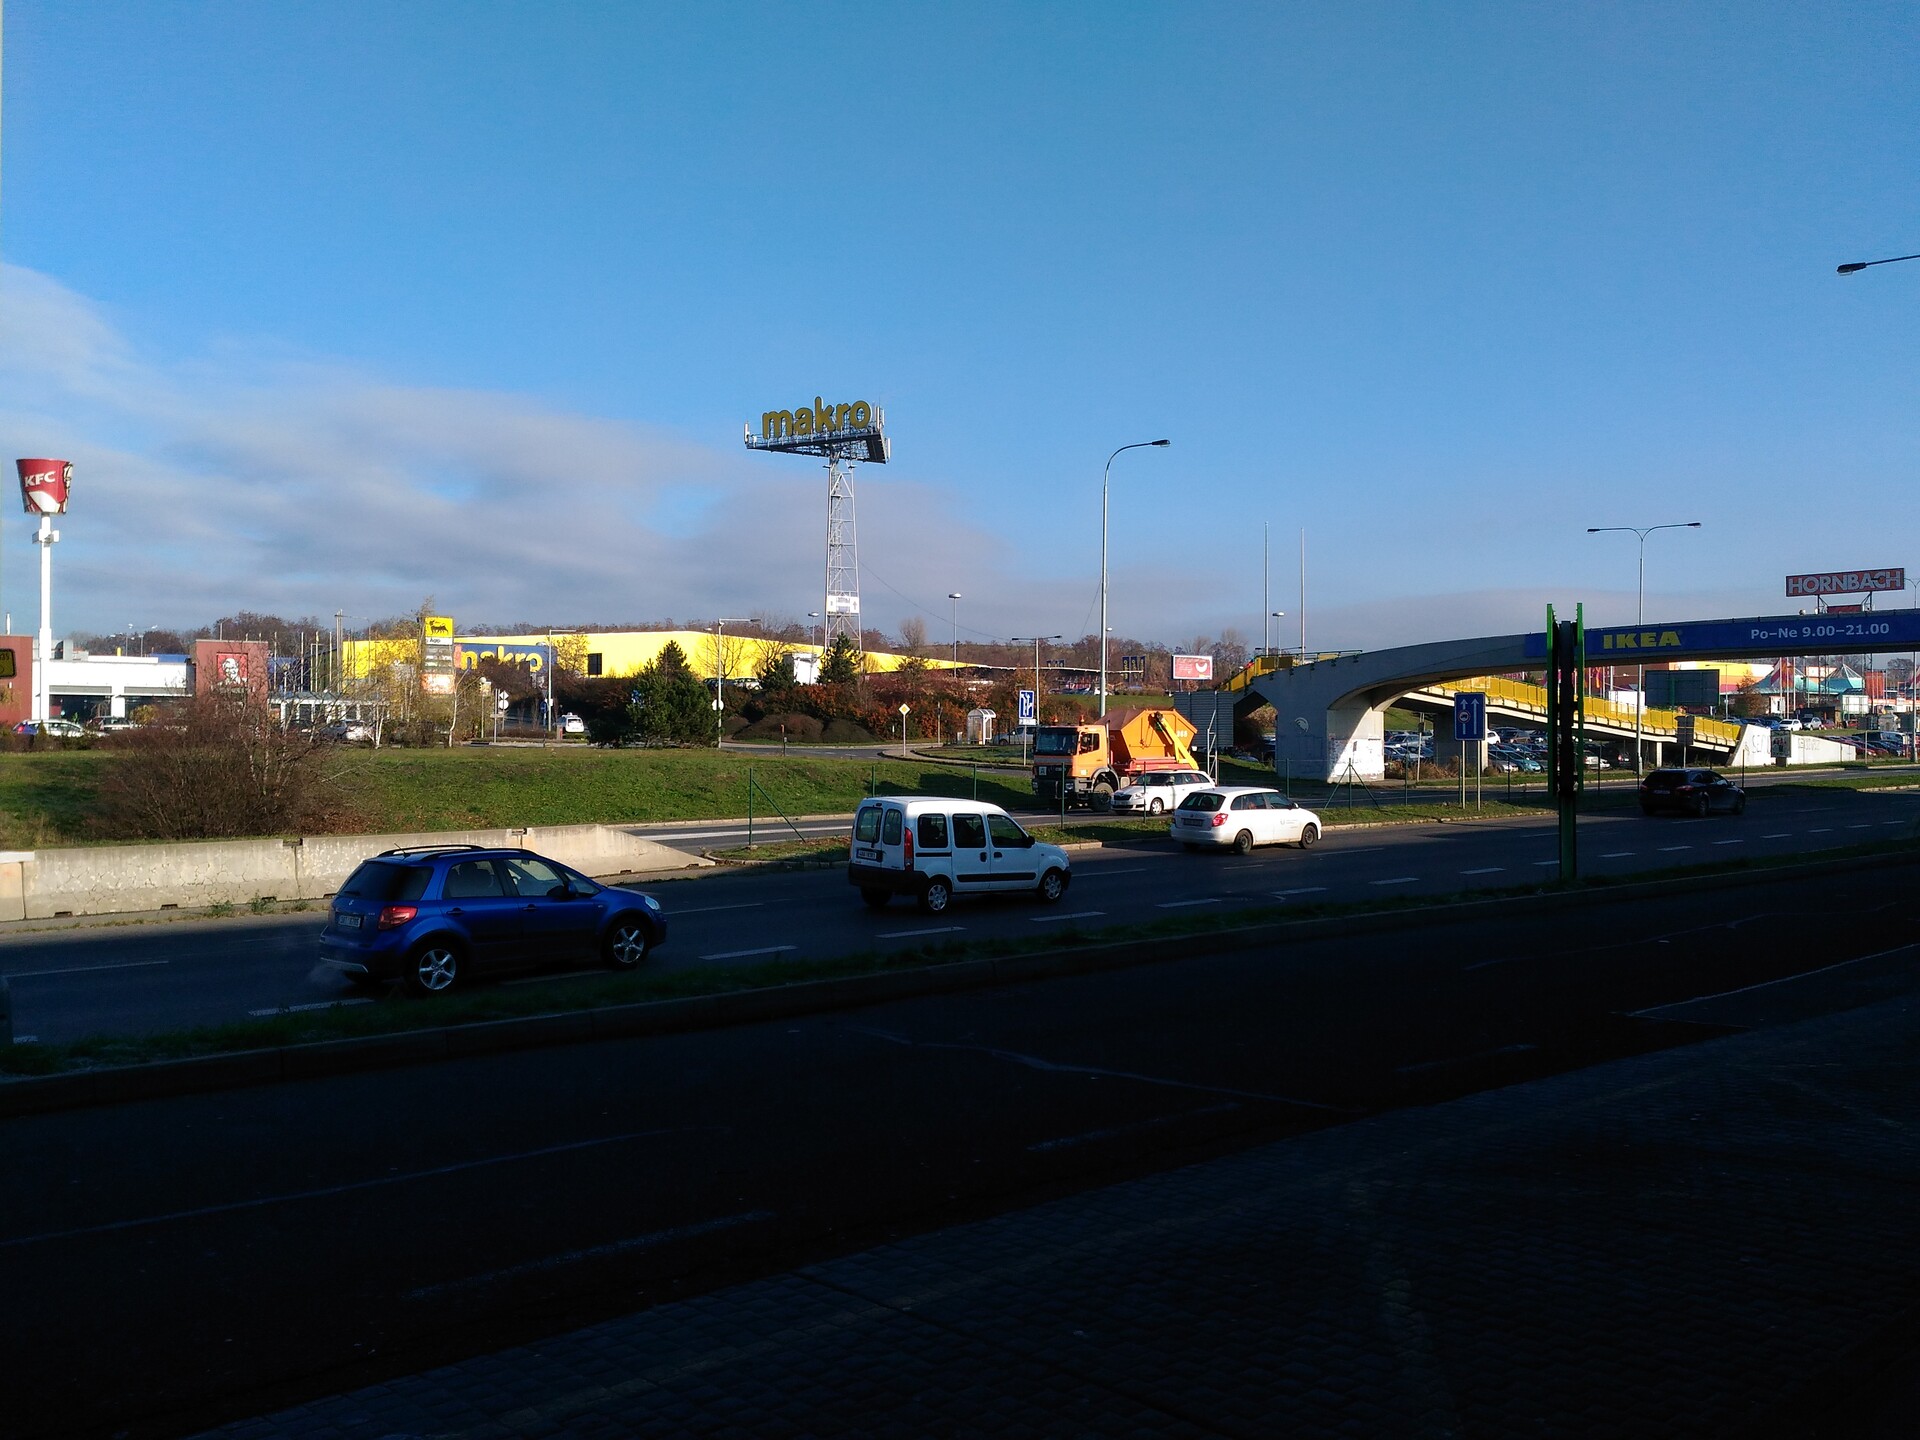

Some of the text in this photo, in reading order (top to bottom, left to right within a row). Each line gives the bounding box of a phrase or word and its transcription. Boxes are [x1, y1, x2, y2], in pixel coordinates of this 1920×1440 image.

[762, 396, 871, 439] makro
[25, 471, 56, 488] KFC
[1788, 570, 1902, 594] HORNBACH
[1603, 630, 1682, 649] IKEA
